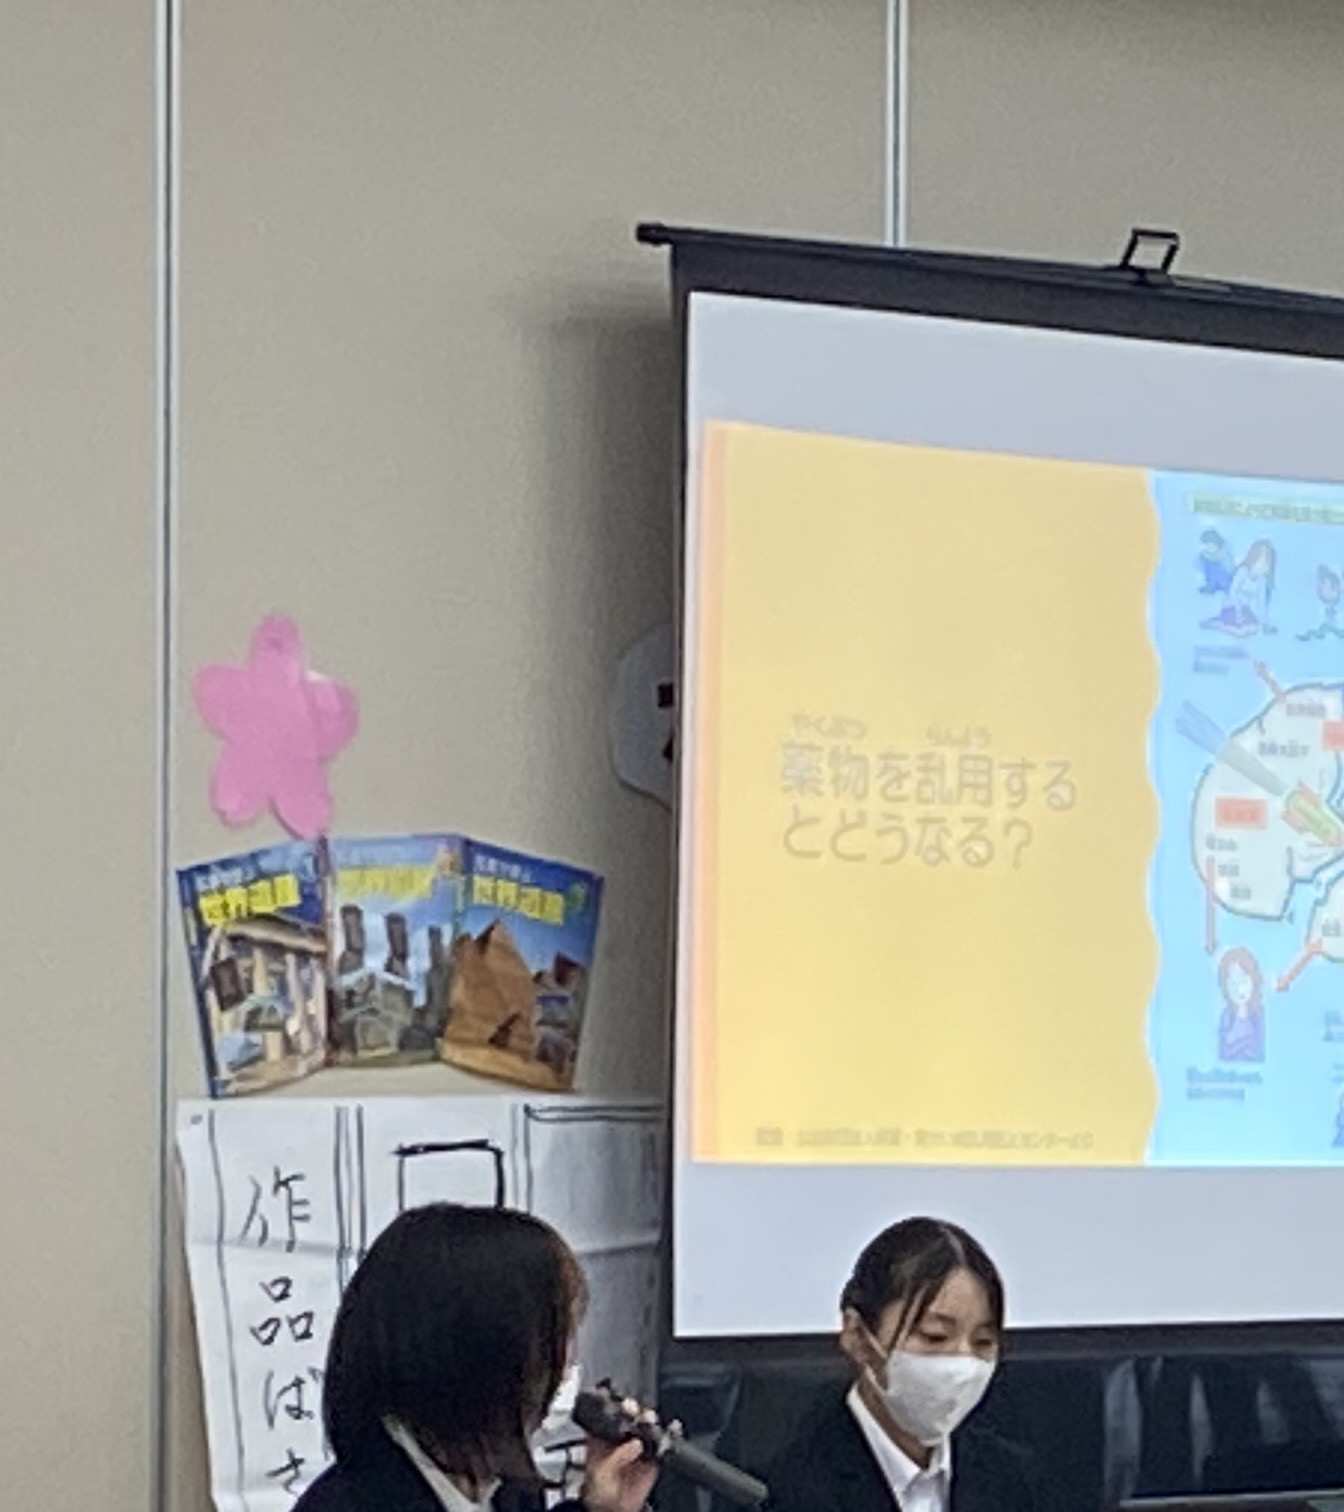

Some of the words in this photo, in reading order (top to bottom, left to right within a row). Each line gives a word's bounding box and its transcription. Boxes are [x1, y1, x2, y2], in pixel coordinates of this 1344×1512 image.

[780, 739, 1078, 812] 薬物を乱用する
[783, 802, 1034, 871] とどうなる?
